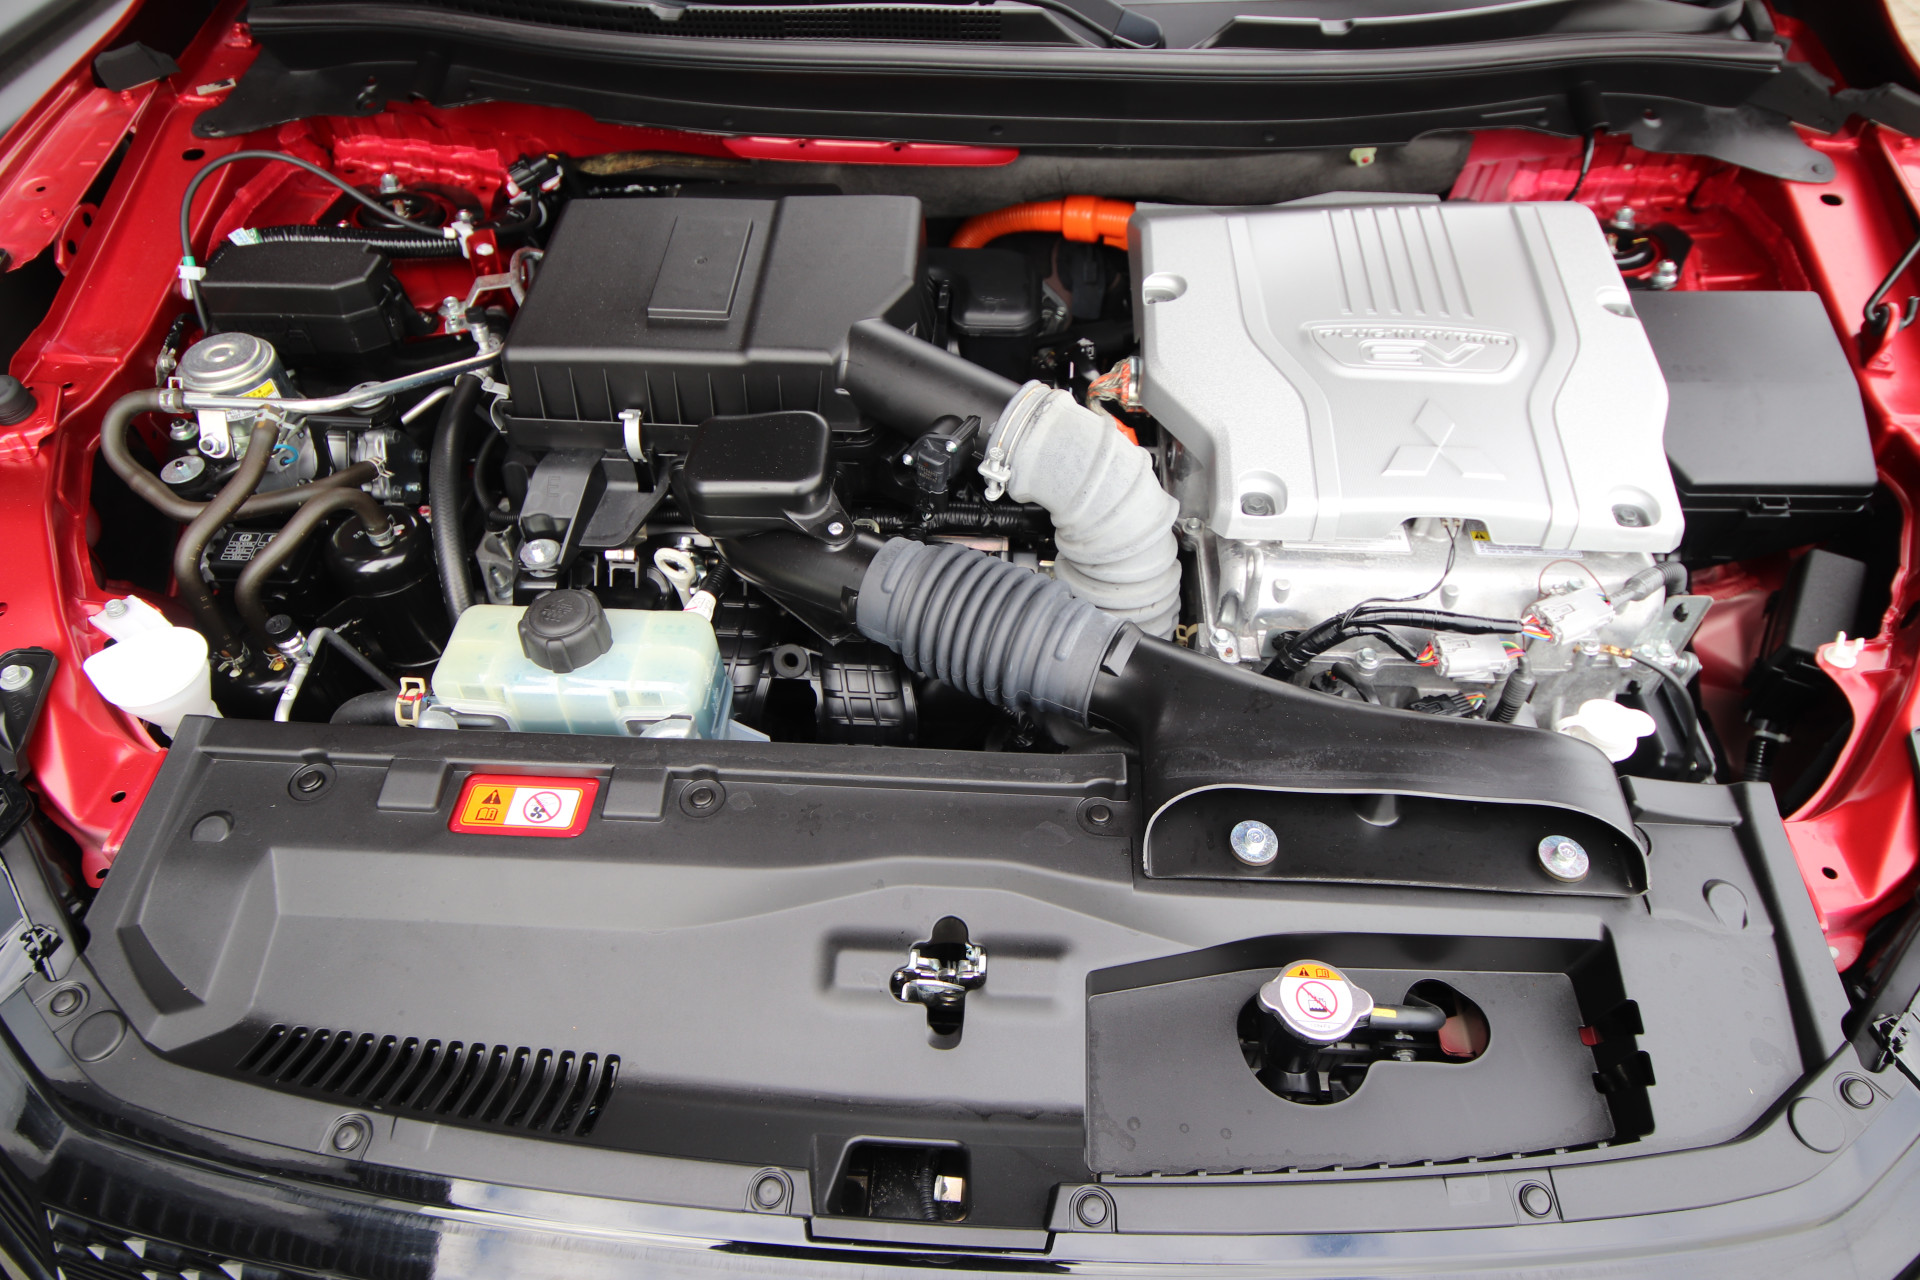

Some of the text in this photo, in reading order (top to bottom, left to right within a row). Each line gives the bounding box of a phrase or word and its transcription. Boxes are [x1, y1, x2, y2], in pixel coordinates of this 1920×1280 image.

[1319, 328, 1509, 345] PLUG-IN HYBRID
[1359, 339, 1485, 366] EV
